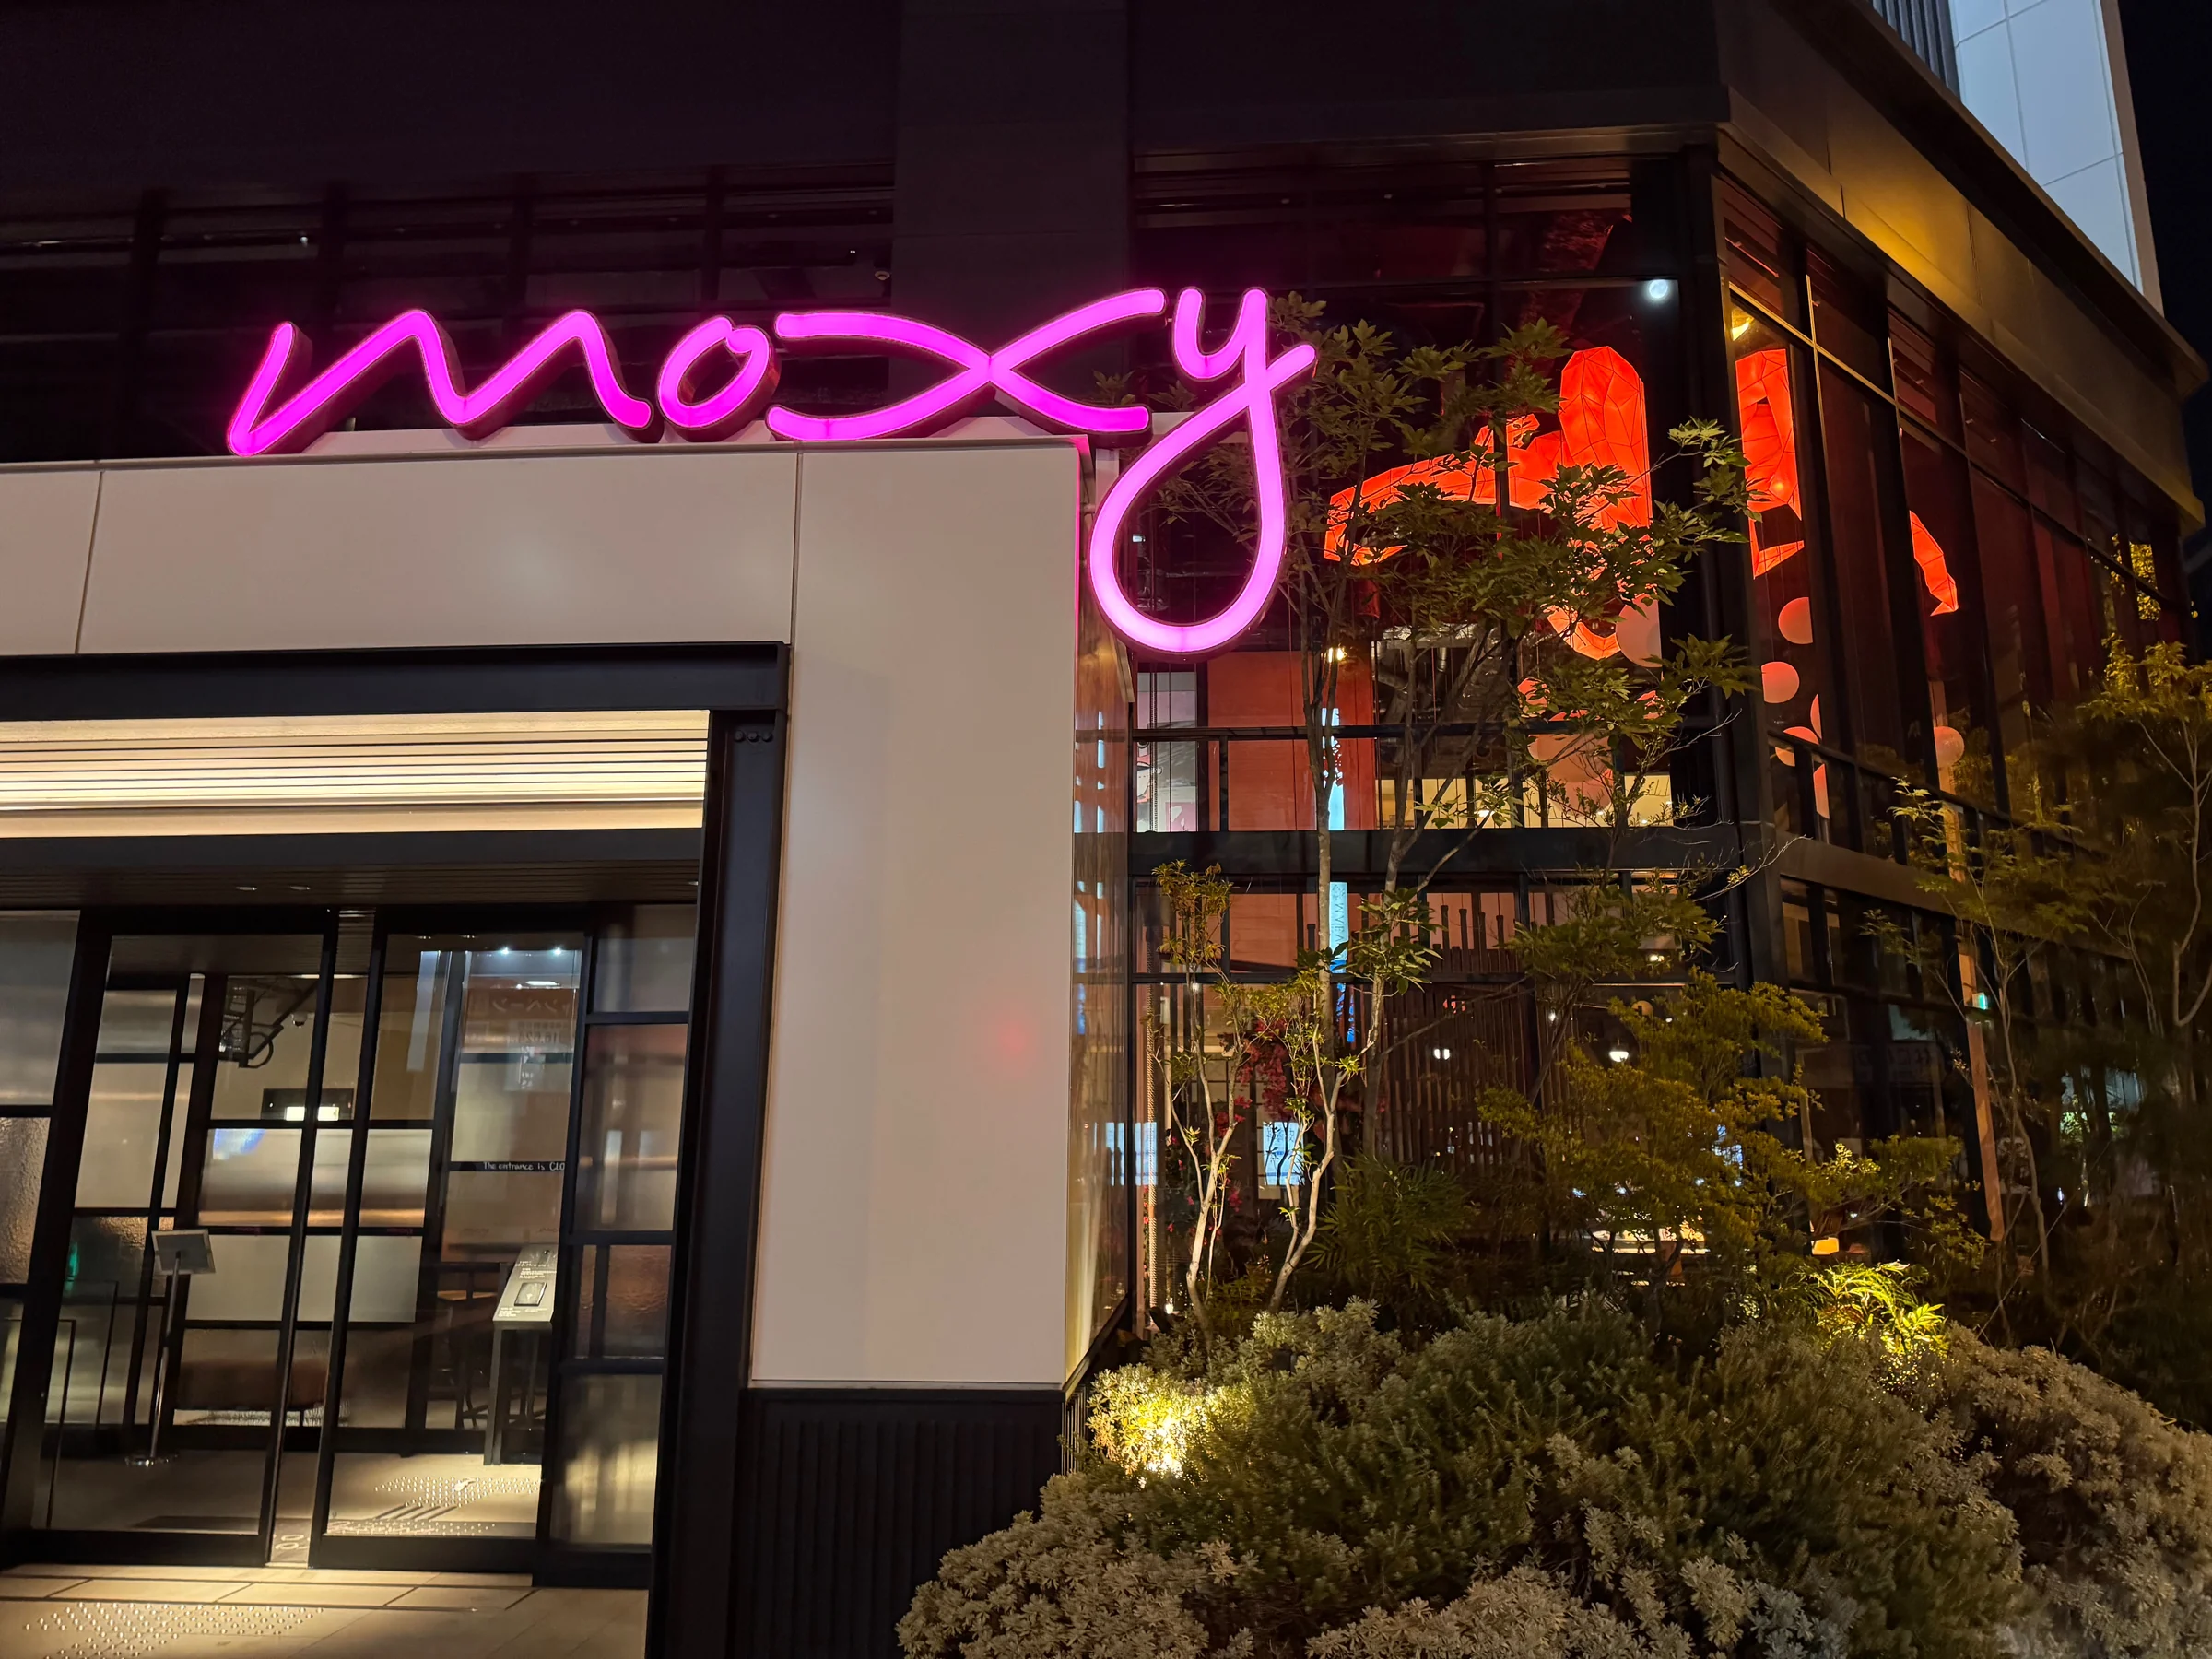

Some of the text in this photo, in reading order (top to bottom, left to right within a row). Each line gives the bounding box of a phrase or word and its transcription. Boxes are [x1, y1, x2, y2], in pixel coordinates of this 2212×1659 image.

[228, 288, 1317, 653] moxy
[483, 1161, 496, 1170] The
[498, 1162, 535, 1171] entrance
